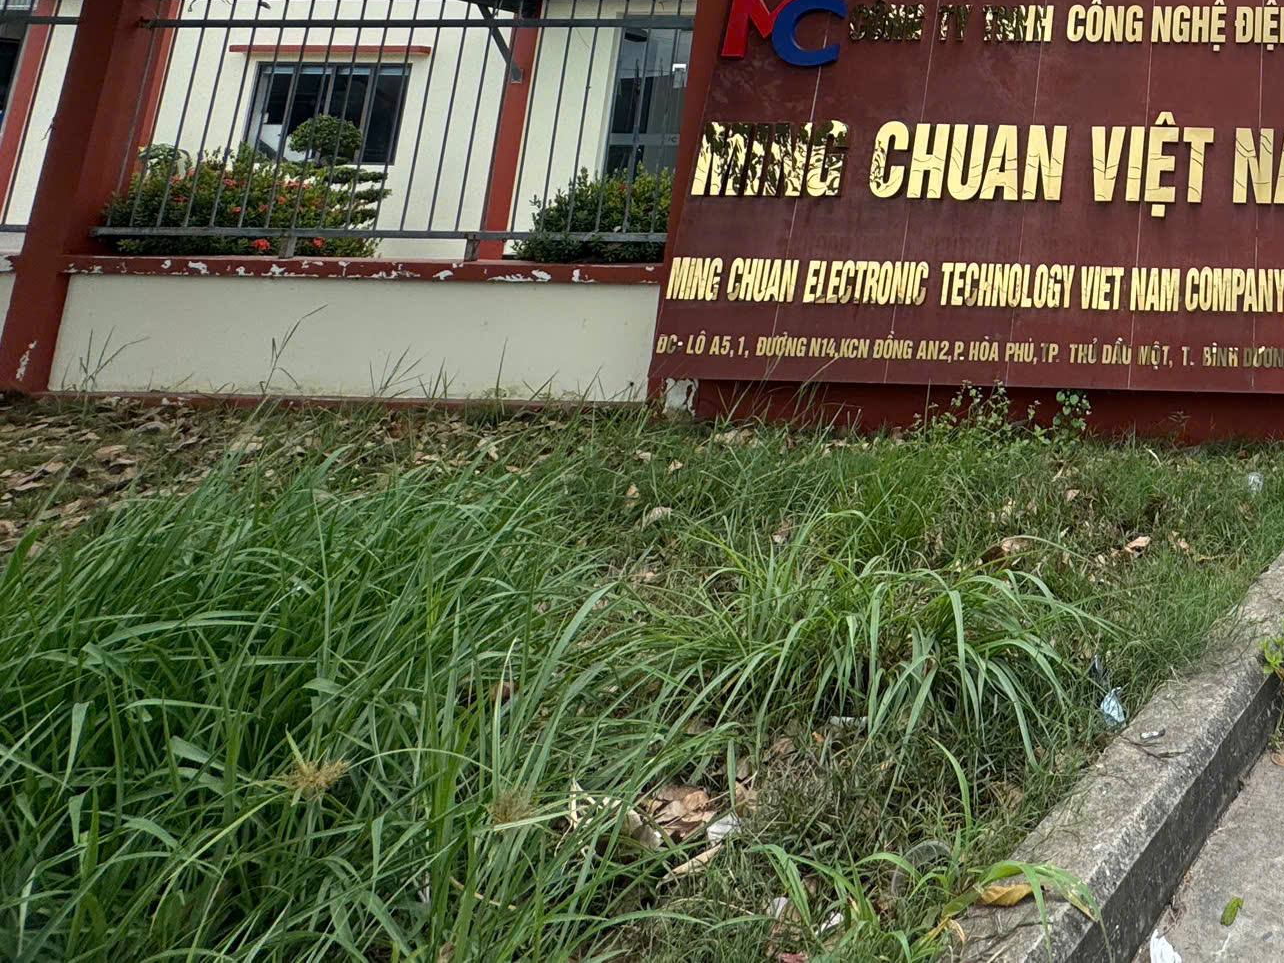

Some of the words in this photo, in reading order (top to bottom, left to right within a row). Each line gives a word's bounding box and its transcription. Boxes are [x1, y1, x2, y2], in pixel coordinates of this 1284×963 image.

[938, 4, 973, 41] TY
[983, 4, 1054, 42] TNHH
[690, 120, 849, 197] MING
[869, 120, 1067, 200] CHUAN
[1092, 111, 1214, 217] VIỆT
[666, 257, 723, 301] MING
[727, 257, 799, 302] CHUAN
[803, 260, 929, 305] ELECTRONIC
[940, 262, 1075, 308] TECHNOLOGY
[1081, 266, 1124, 310] VIET
[1130, 268, 1181, 311] NAM
[686, 330, 706, 354] LÔ
[873, 330, 913, 359] ĐỒNG
[969, 336, 999, 361] HÒA
[1069, 338, 1098, 364] THỦ
[1182, 346, 1195, 366] T.
[1202, 342, 1239, 367] BÌNH
